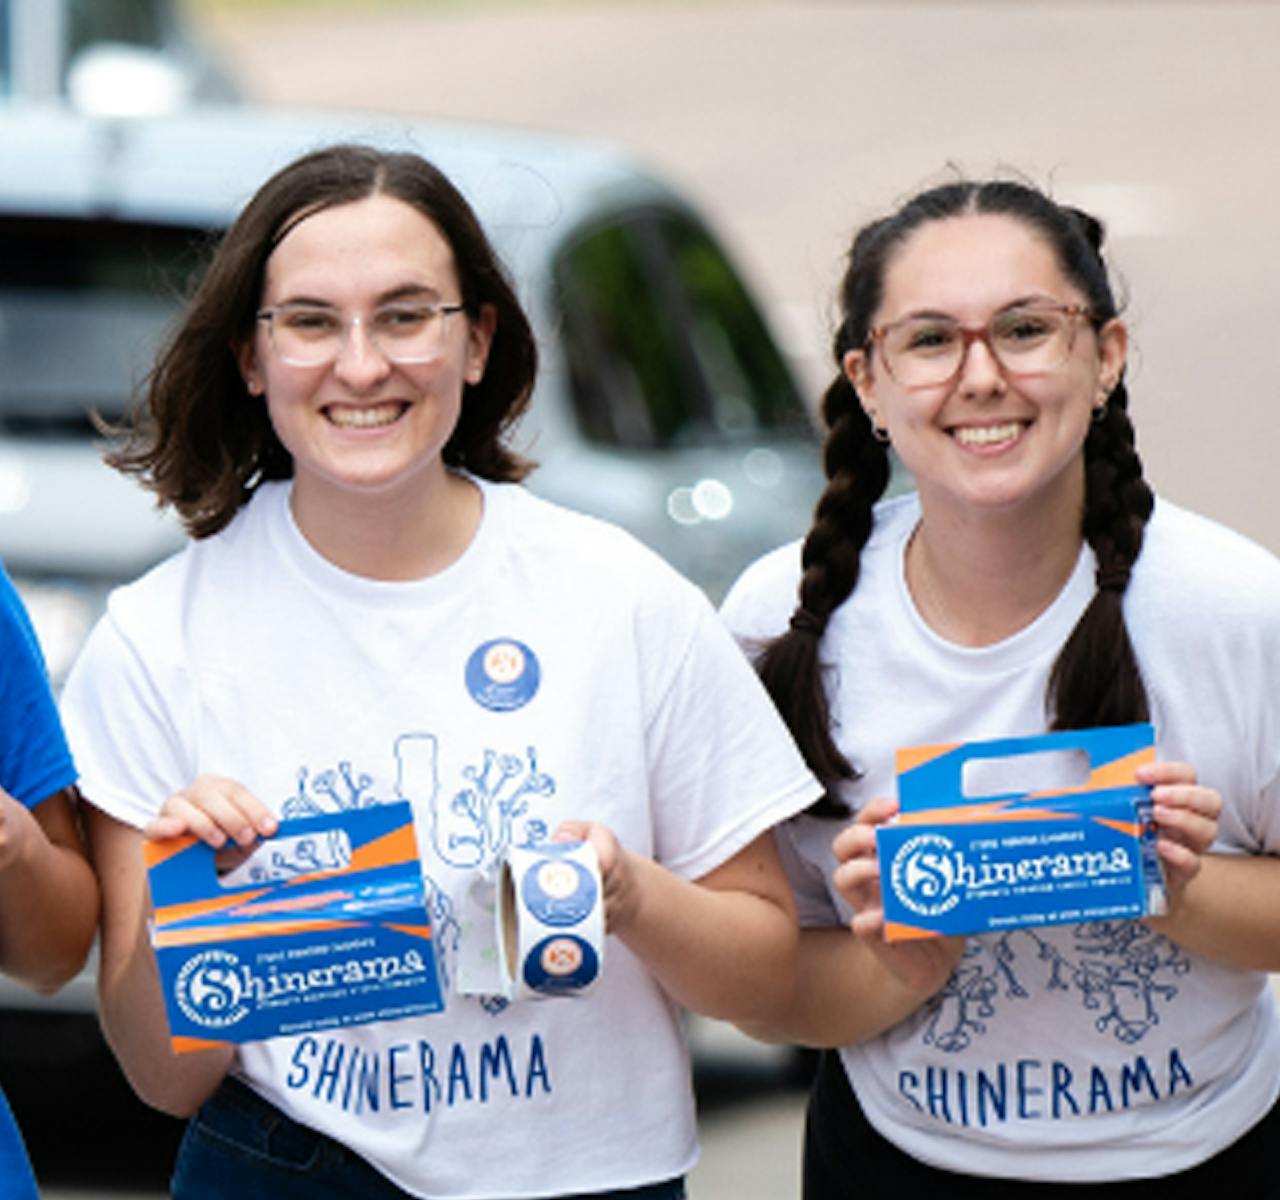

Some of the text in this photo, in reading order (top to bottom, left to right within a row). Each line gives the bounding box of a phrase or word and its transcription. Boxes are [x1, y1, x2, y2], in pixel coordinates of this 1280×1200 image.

[905, 846, 1133, 897] Shinerama
[190, 949, 427, 1011] Shinerama
[285, 1034, 552, 1114] SHINERAMA
[899, 1047, 1193, 1128] SHINERAMA
